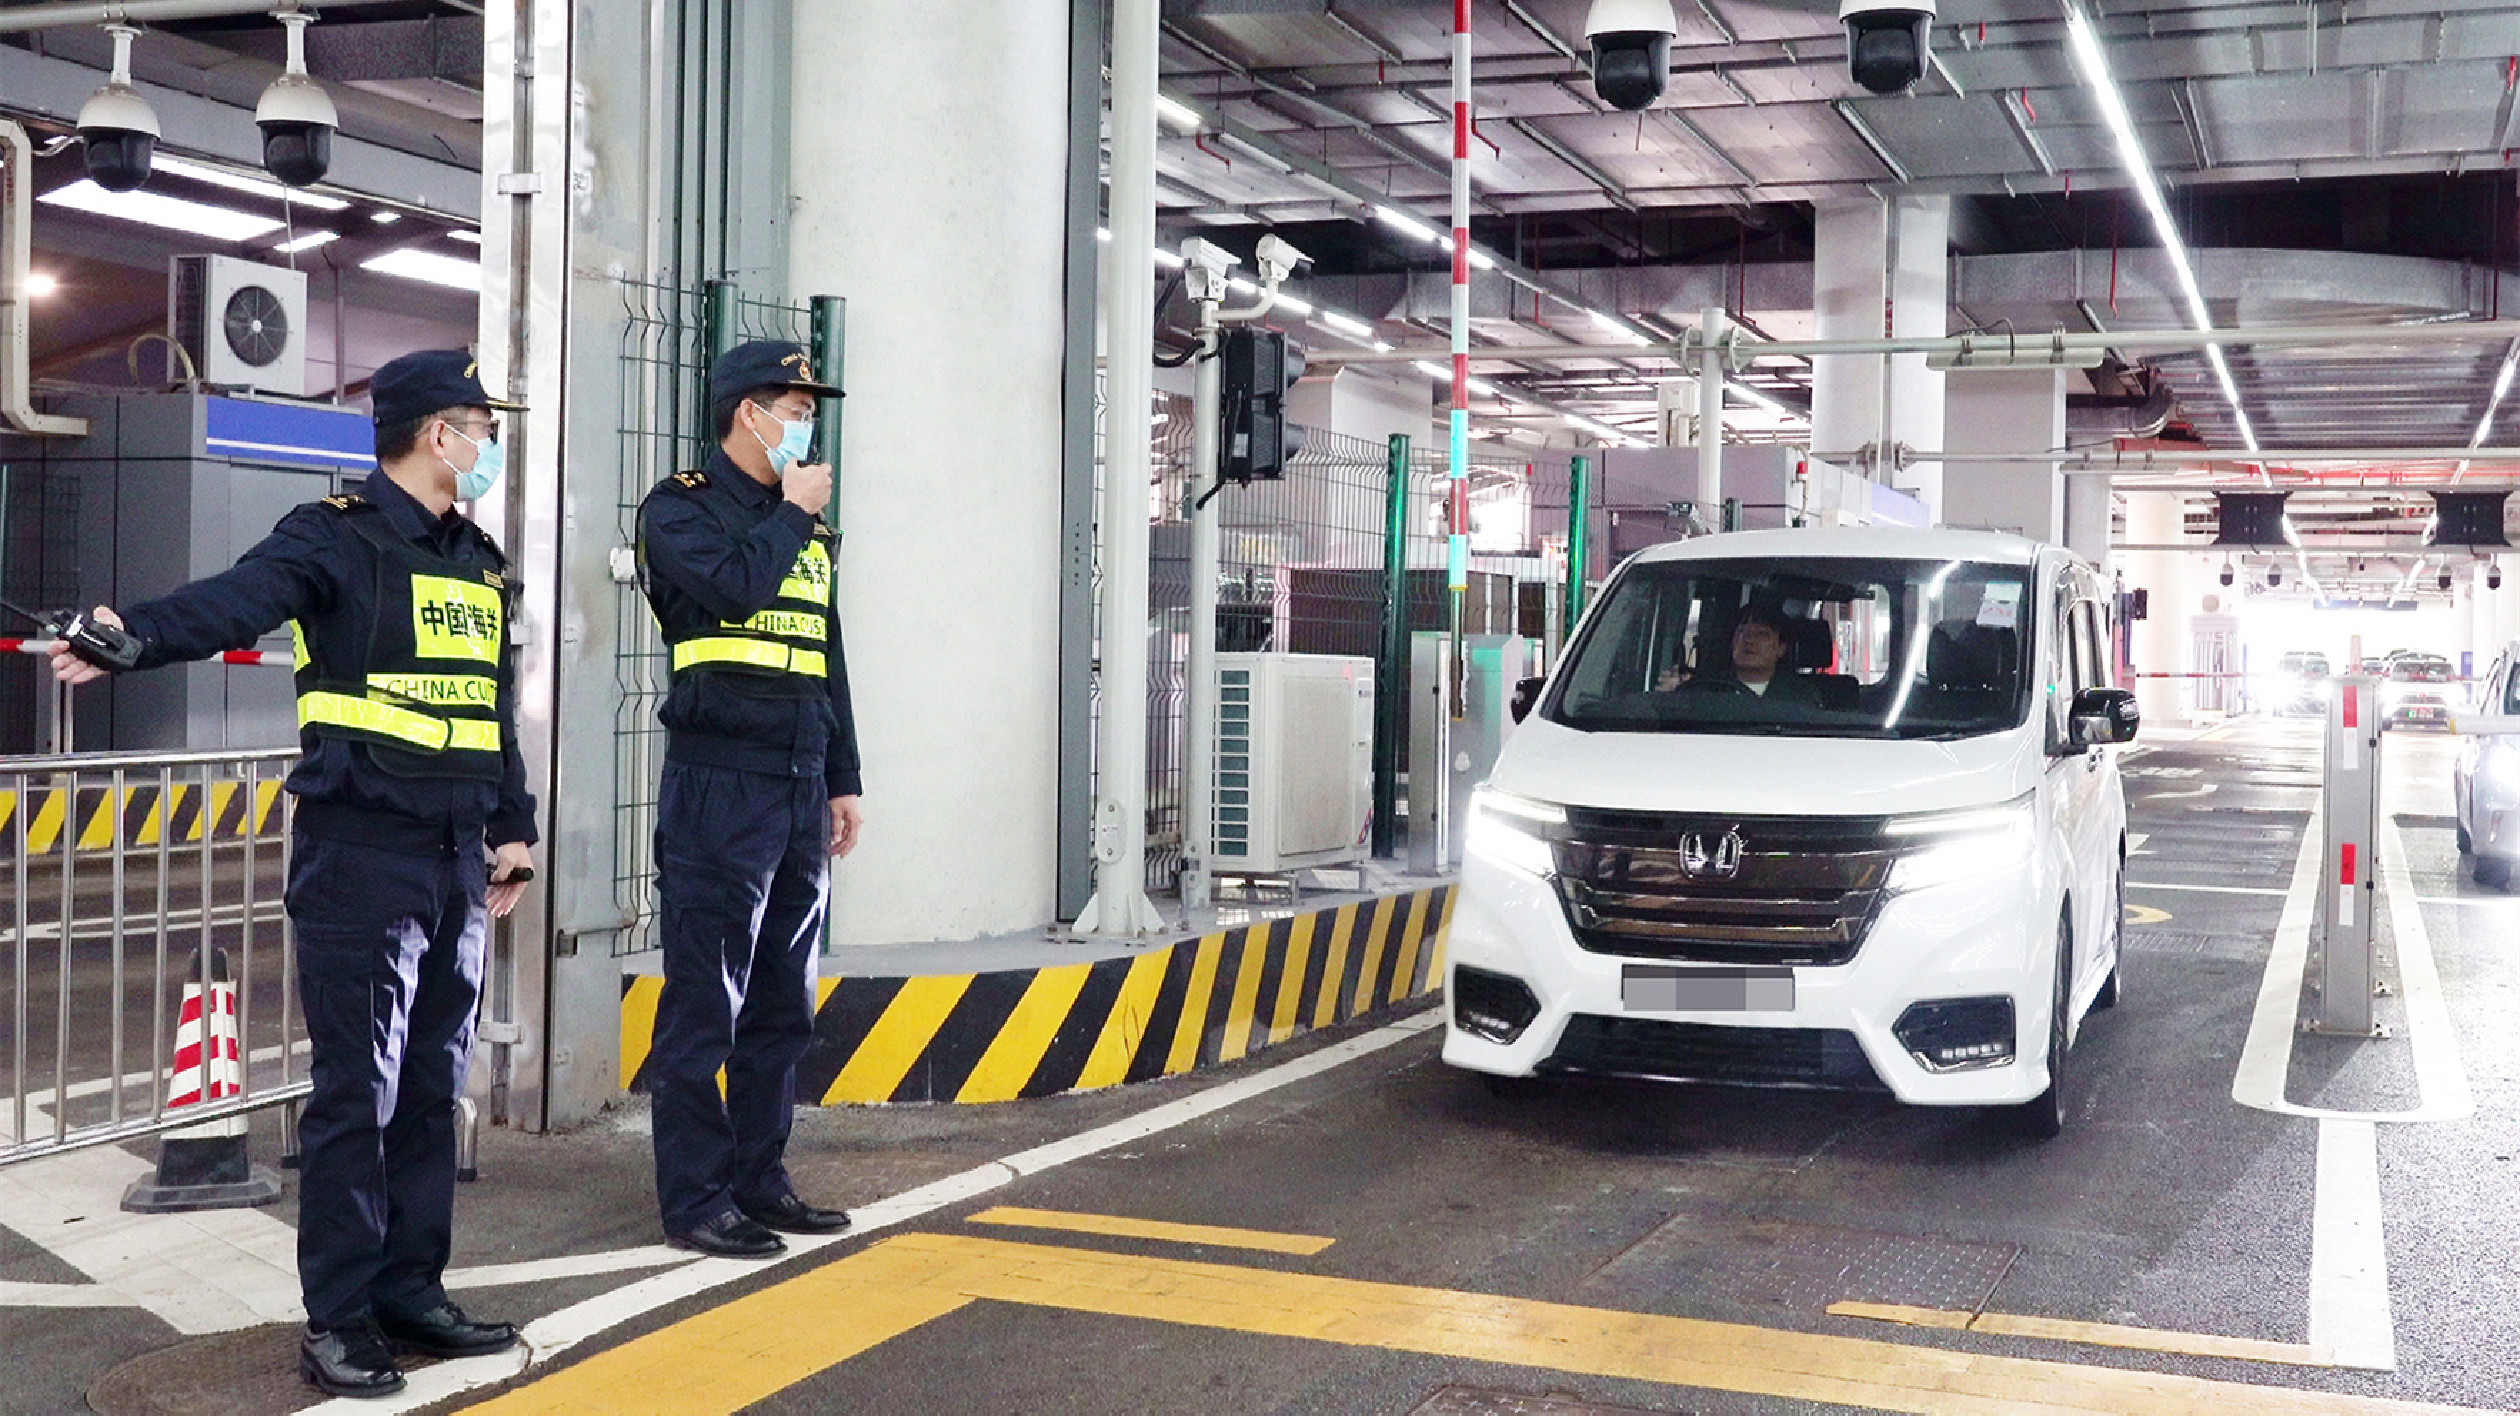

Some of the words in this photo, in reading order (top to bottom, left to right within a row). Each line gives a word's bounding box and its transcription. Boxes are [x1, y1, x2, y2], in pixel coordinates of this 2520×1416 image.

[420, 600, 498, 641] 中国海关
[754, 614, 799, 632] HINA
[387, 680, 461, 701] CHINA
